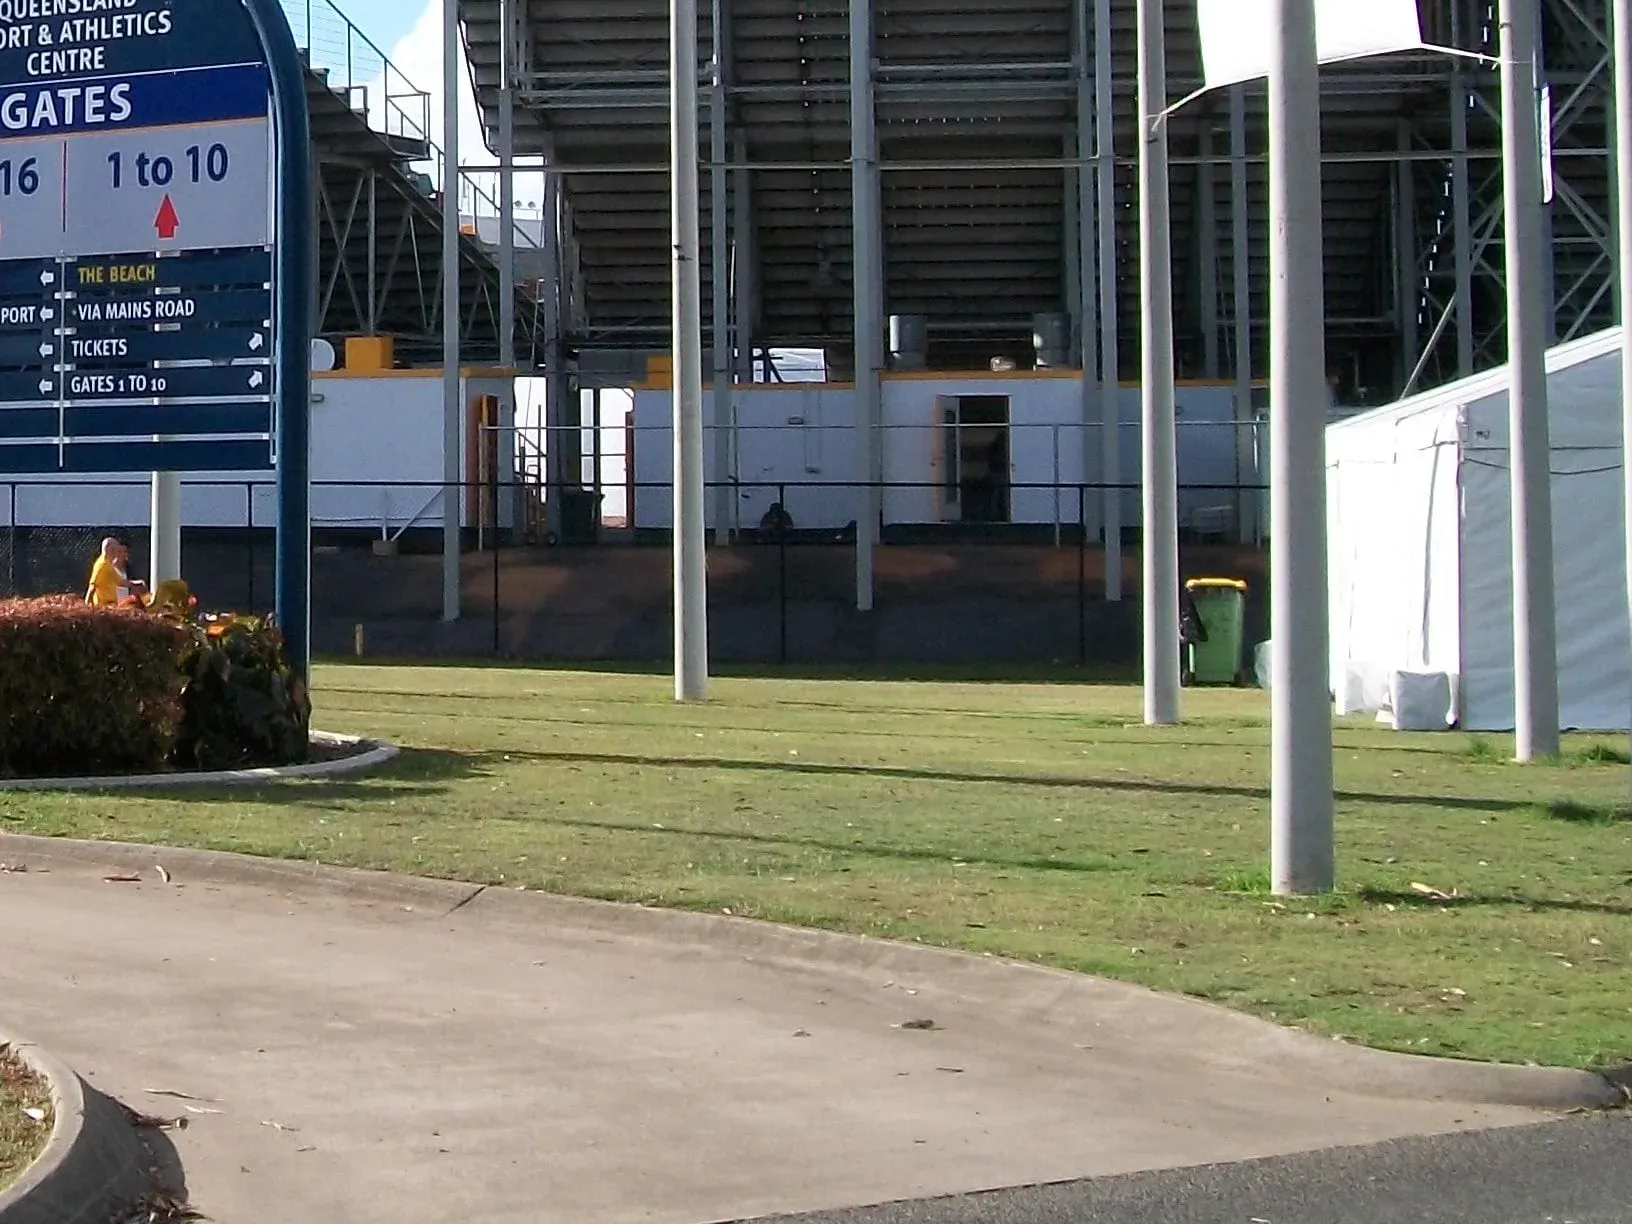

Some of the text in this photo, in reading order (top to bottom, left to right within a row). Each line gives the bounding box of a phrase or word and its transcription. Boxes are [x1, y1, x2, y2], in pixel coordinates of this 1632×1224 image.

[37, 24, 53, 45] &
[59, 10, 172, 43] ATHLETICS
[26, 47, 106, 75] CENTRE
[0, 83, 132, 130] GATES
[107, 143, 228, 188] 1 to 10
[78, 265, 156, 284] THE BEACH
[77, 299, 195, 321] VIA MAINS ROAD
[71, 339, 128, 356] TICKETS
[71, 375, 166, 393] GATES 1 TO 10
